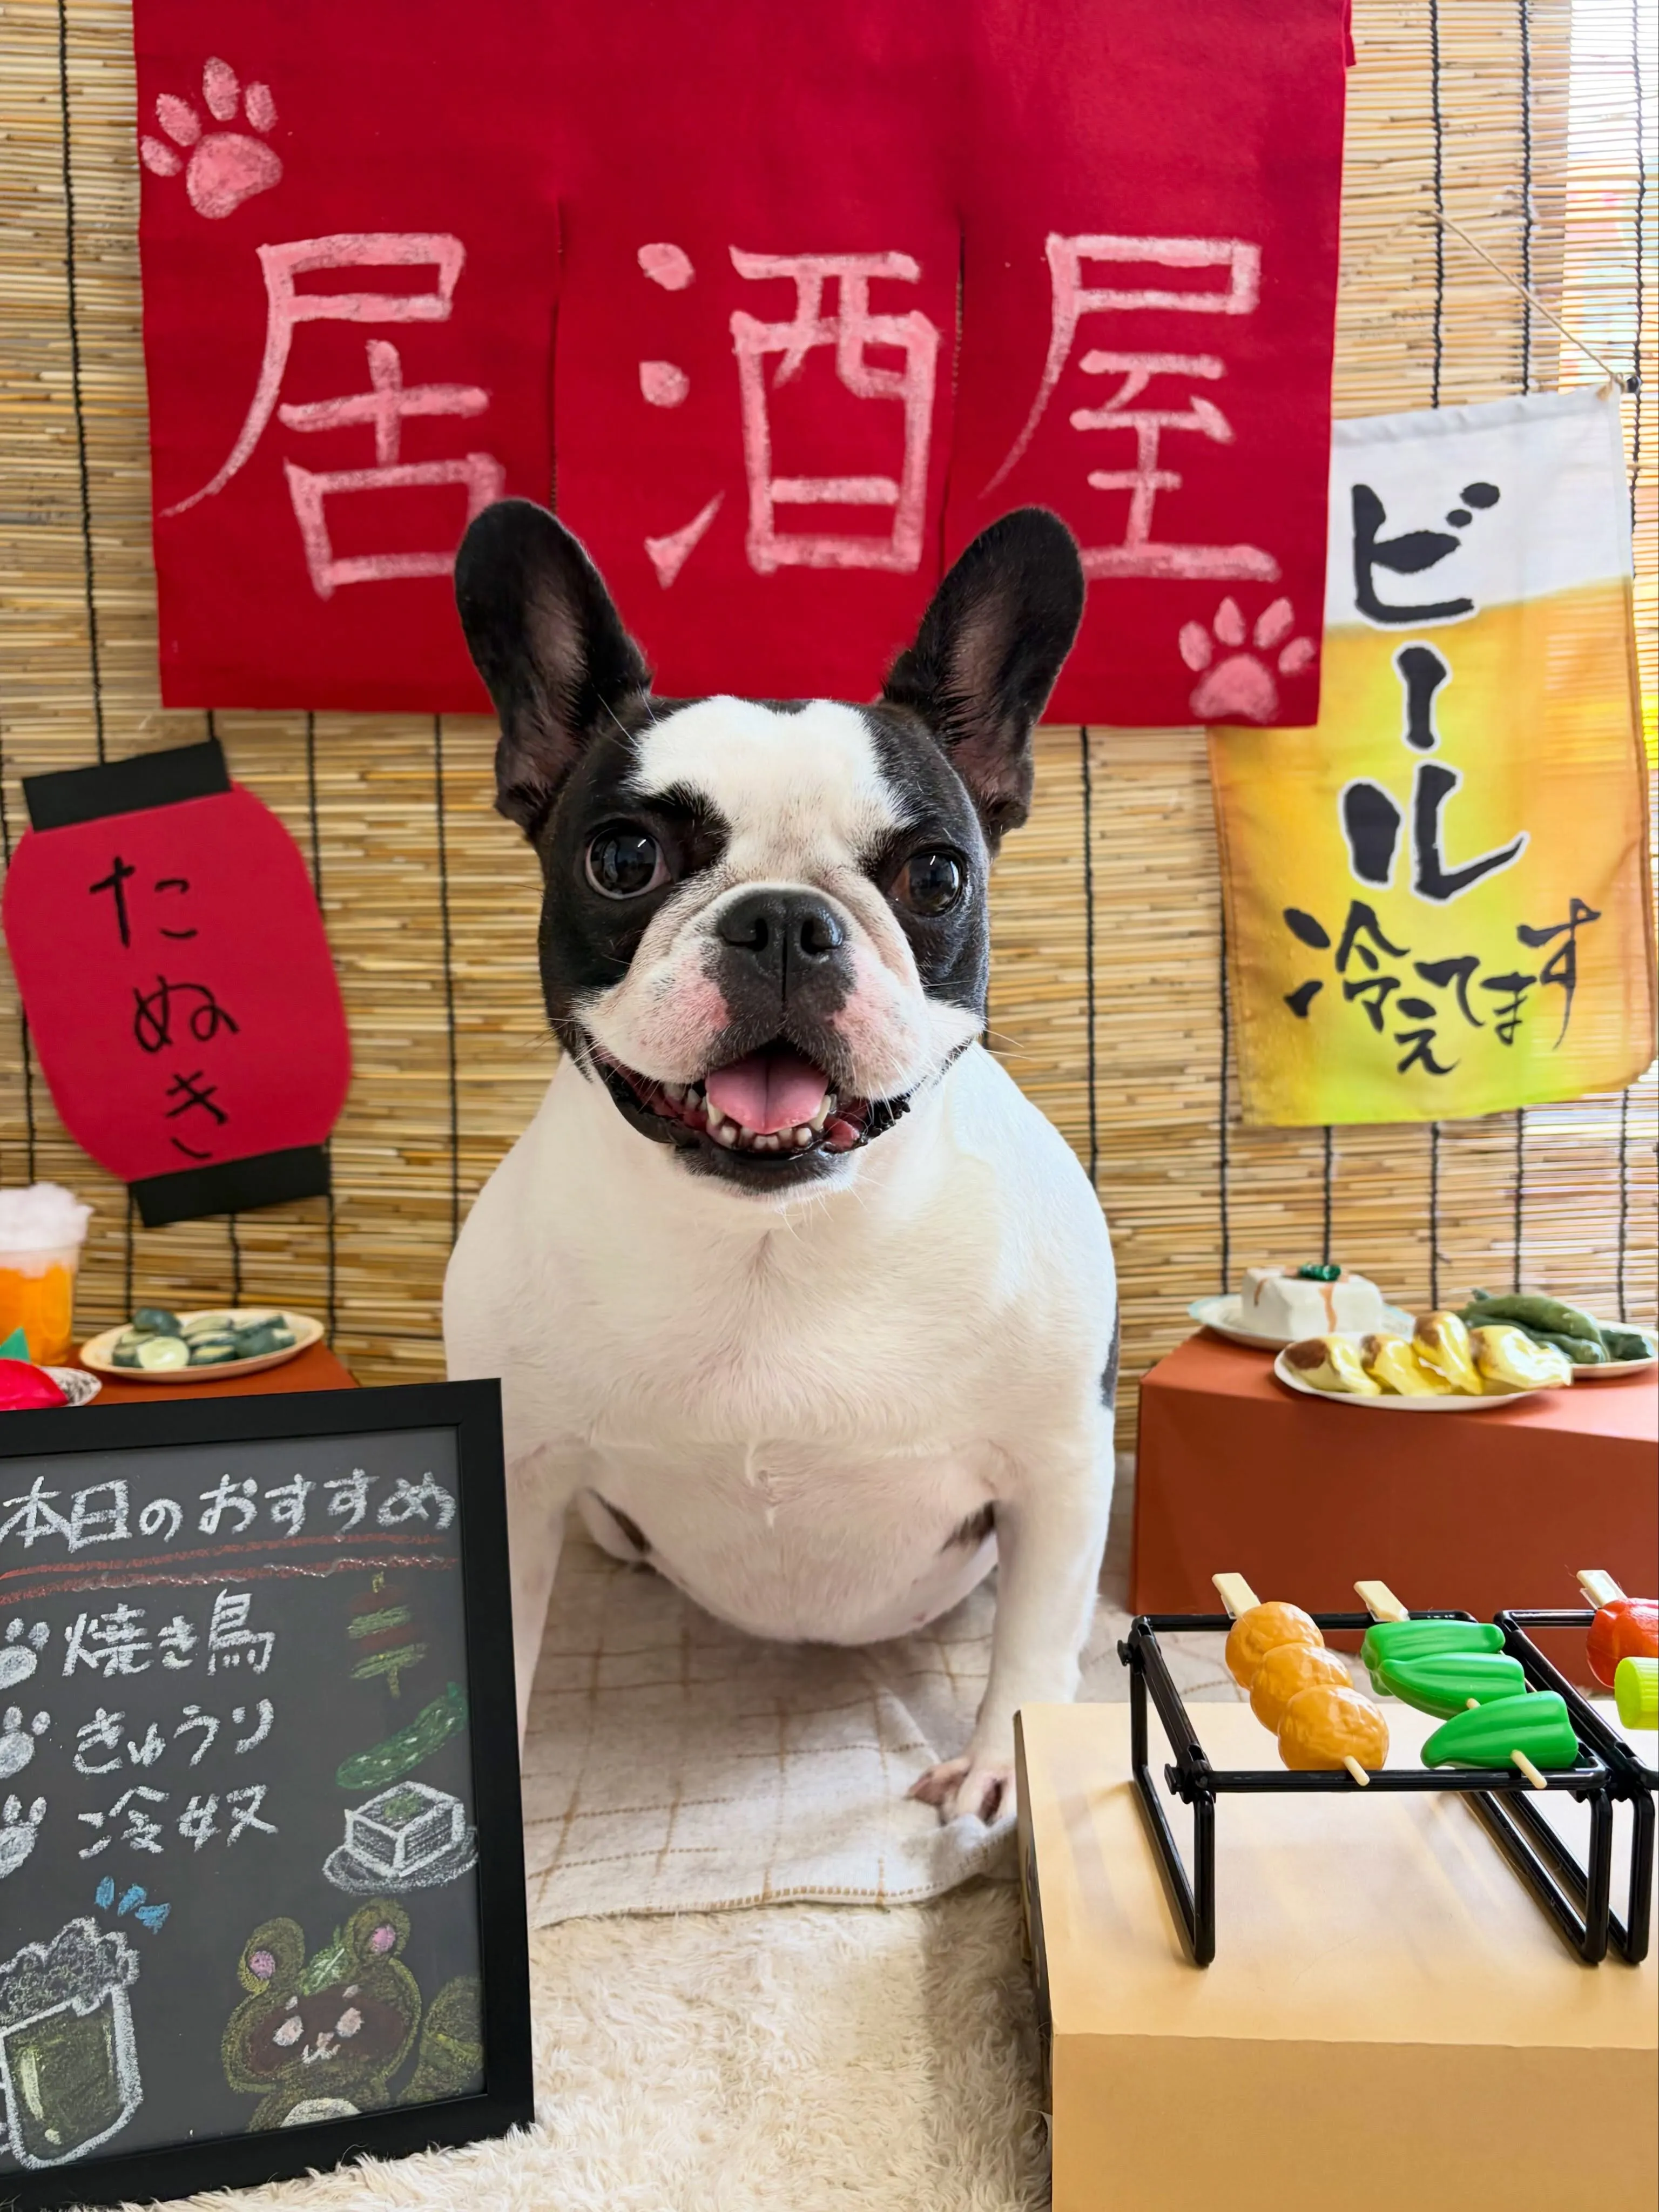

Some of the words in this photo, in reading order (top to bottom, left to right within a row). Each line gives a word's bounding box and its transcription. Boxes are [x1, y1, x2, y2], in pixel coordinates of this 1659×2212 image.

[160, 232, 1280, 598] 居酒屋
[1343, 482, 1529, 901] ビール
[89, 856, 240, 1160] たぬき
[1283, 896, 1601, 1078] 冷えてます
[0, 1468, 457, 1553] 本日のおすすめ
[62, 1588, 276, 1678] 焼き鳥
[73, 1698, 275, 1775] きゅうり
[78, 1784, 279, 1859] 冷奴
